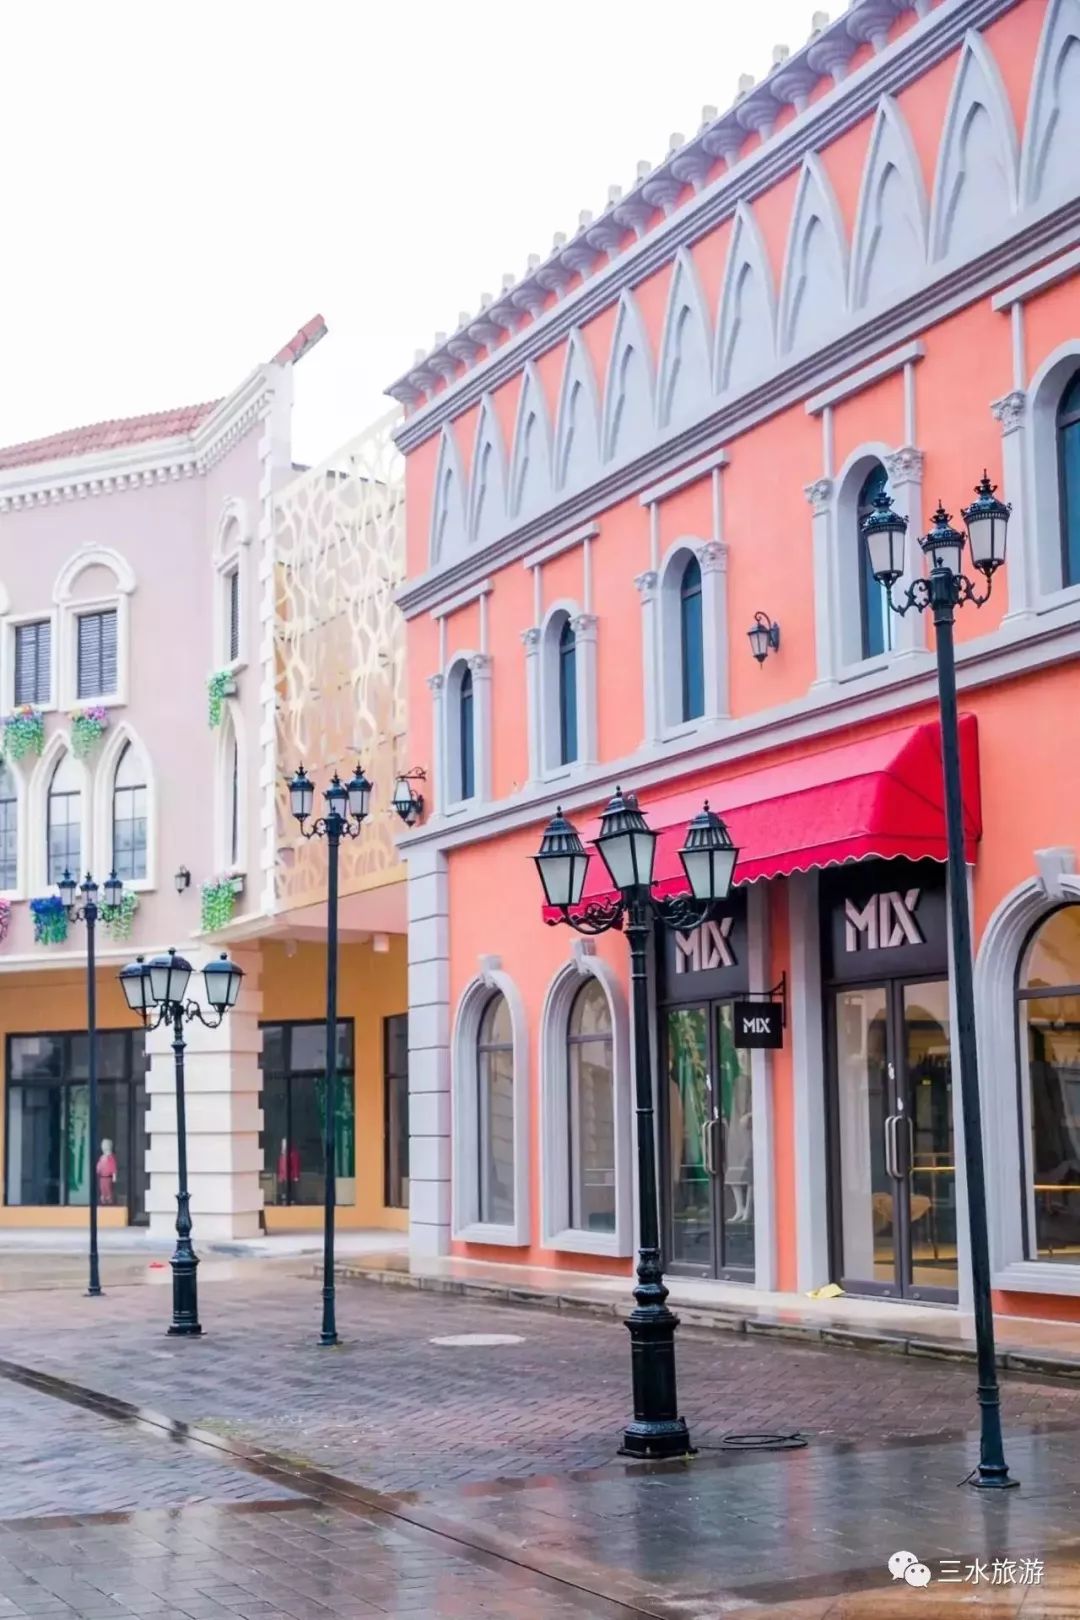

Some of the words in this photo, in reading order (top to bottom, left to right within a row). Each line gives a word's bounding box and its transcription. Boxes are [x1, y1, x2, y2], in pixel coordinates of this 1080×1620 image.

[675, 917, 737, 974] MIX
[845, 888, 925, 952] MIX
[743, 1017, 771, 1034] MIX
